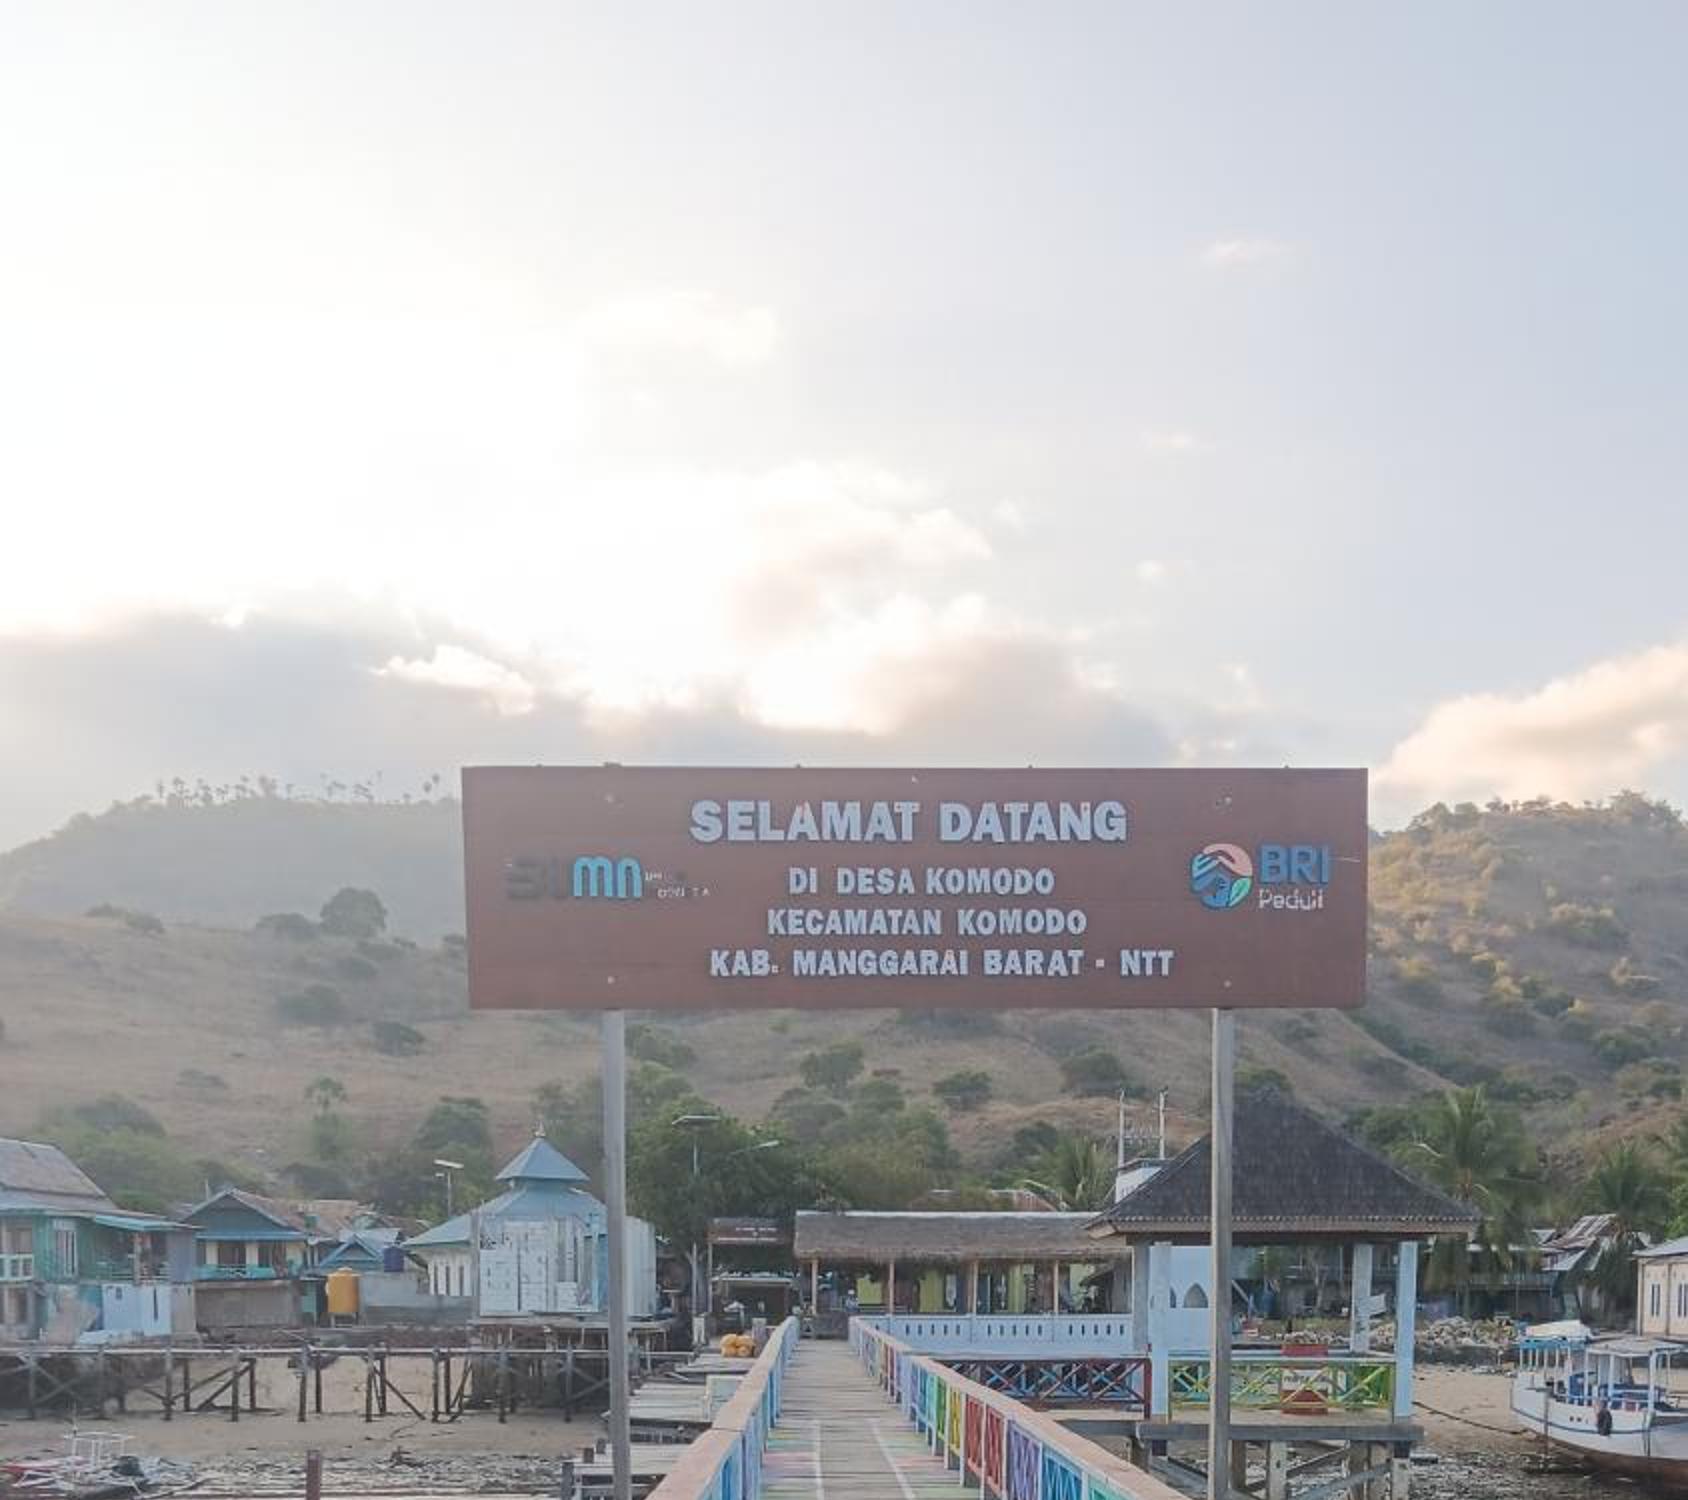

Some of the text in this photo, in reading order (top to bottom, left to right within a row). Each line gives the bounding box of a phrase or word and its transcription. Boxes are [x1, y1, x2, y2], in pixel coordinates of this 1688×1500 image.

[689, 799, 1127, 843] SELAMAT DATANG
[1259, 844, 1329, 884] BRI
[788, 867, 1055, 895] DI DESA KOMODO
[767, 908, 1087, 936] KECAMATAN KOMODO
[710, 949, 779, 977] KAB.
[792, 949, 969, 976] MANGGARAI
[983, 949, 1084, 976] BARAT
[1120, 949, 1174, 976] NTT
